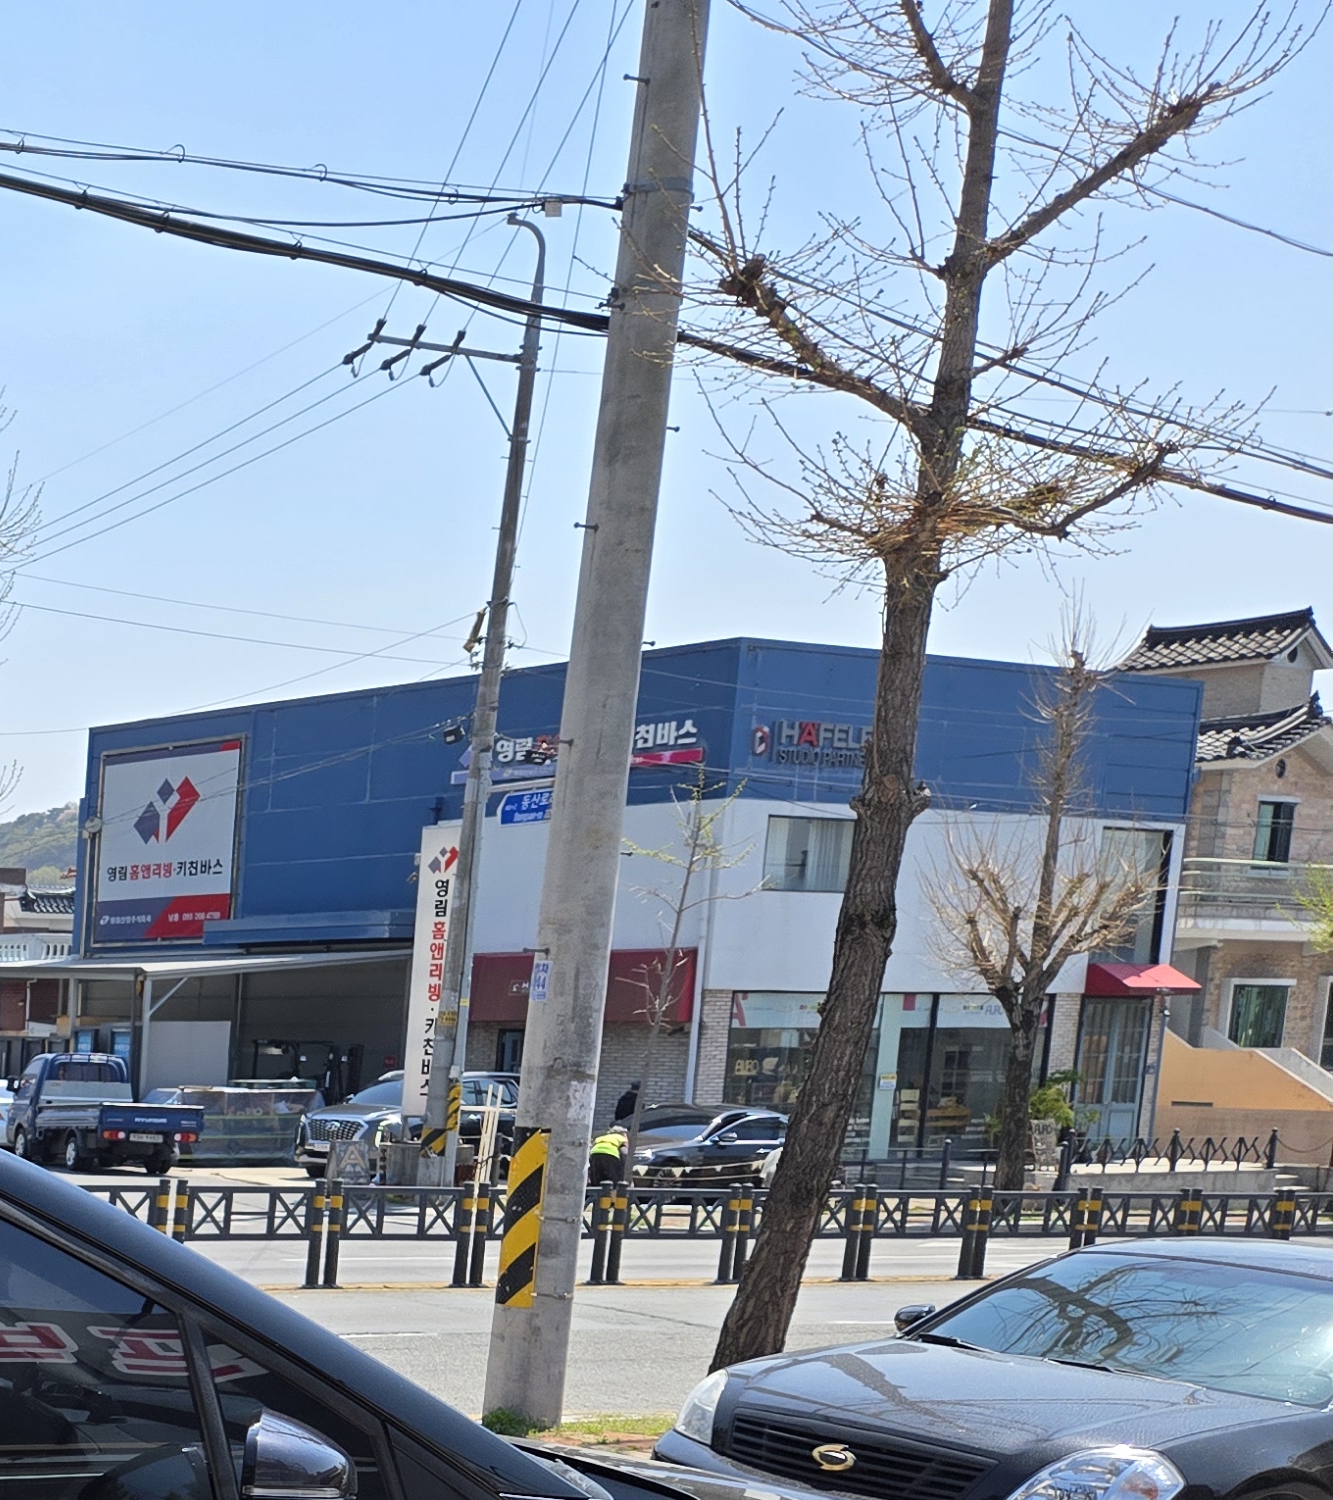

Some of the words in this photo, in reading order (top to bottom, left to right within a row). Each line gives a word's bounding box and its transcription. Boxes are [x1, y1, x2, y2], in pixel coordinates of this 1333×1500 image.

[779, 748, 820, 765] STUDIO
[107, 866, 128, 882] 영림
[434, 878, 450, 918] 영림
